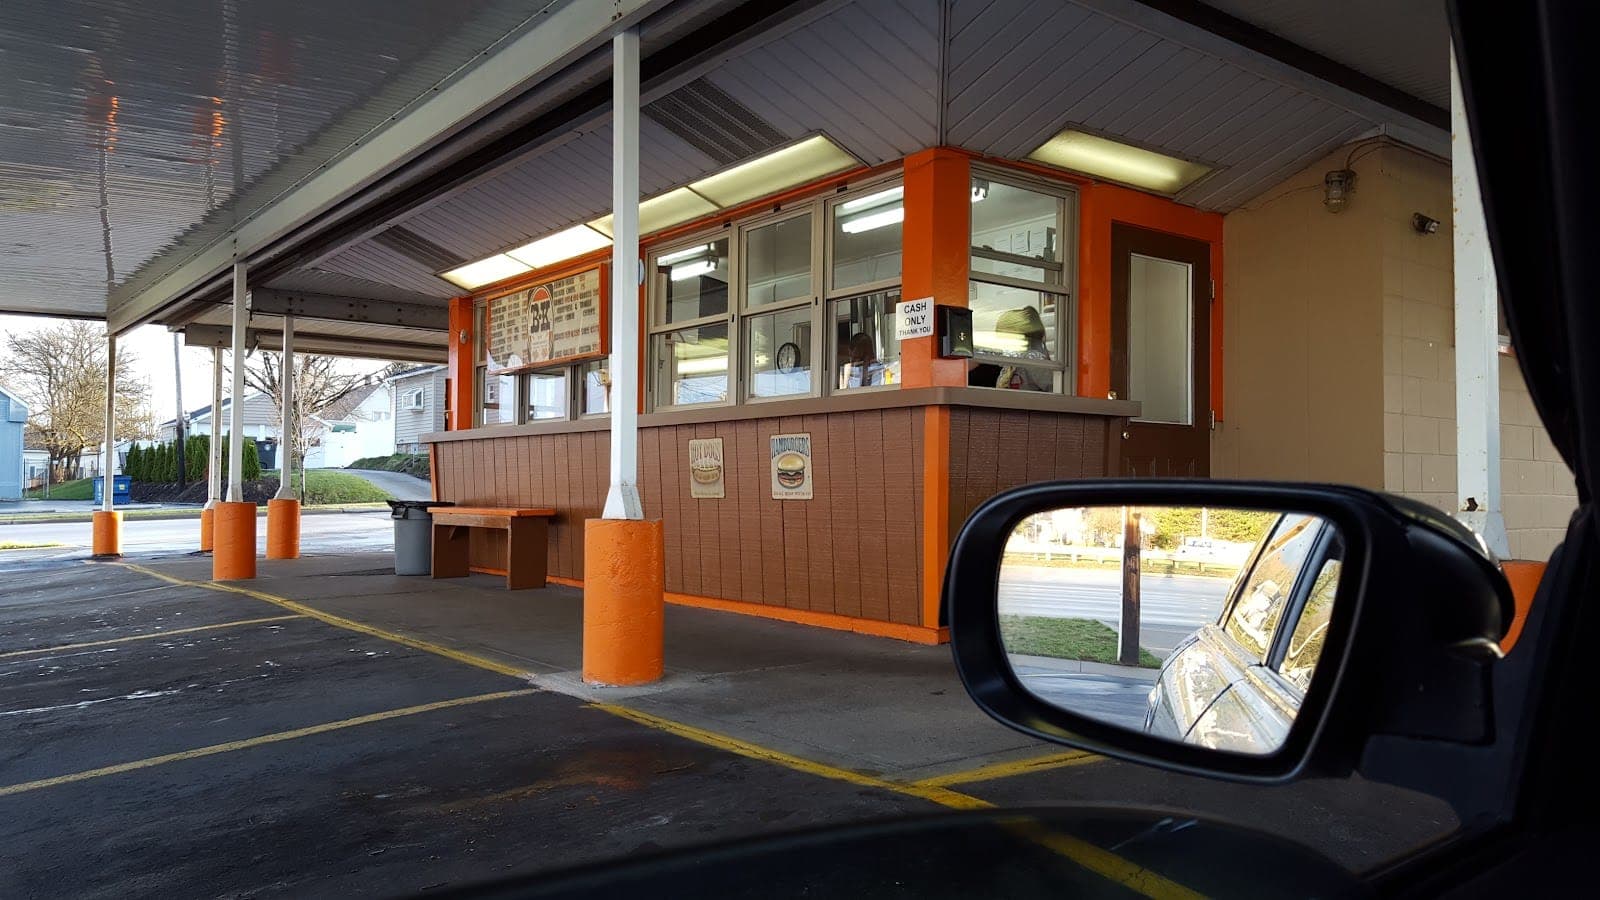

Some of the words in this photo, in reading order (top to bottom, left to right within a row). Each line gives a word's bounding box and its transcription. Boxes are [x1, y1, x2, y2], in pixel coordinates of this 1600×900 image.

[904, 301, 926, 314] CASH
[904, 314, 926, 326] ONLY
[899, 328, 918, 336] THANK
[690, 441, 702, 464] HOT
[703, 440, 721, 462] DOGS
[771, 437, 809, 460] HAMBURGERS
